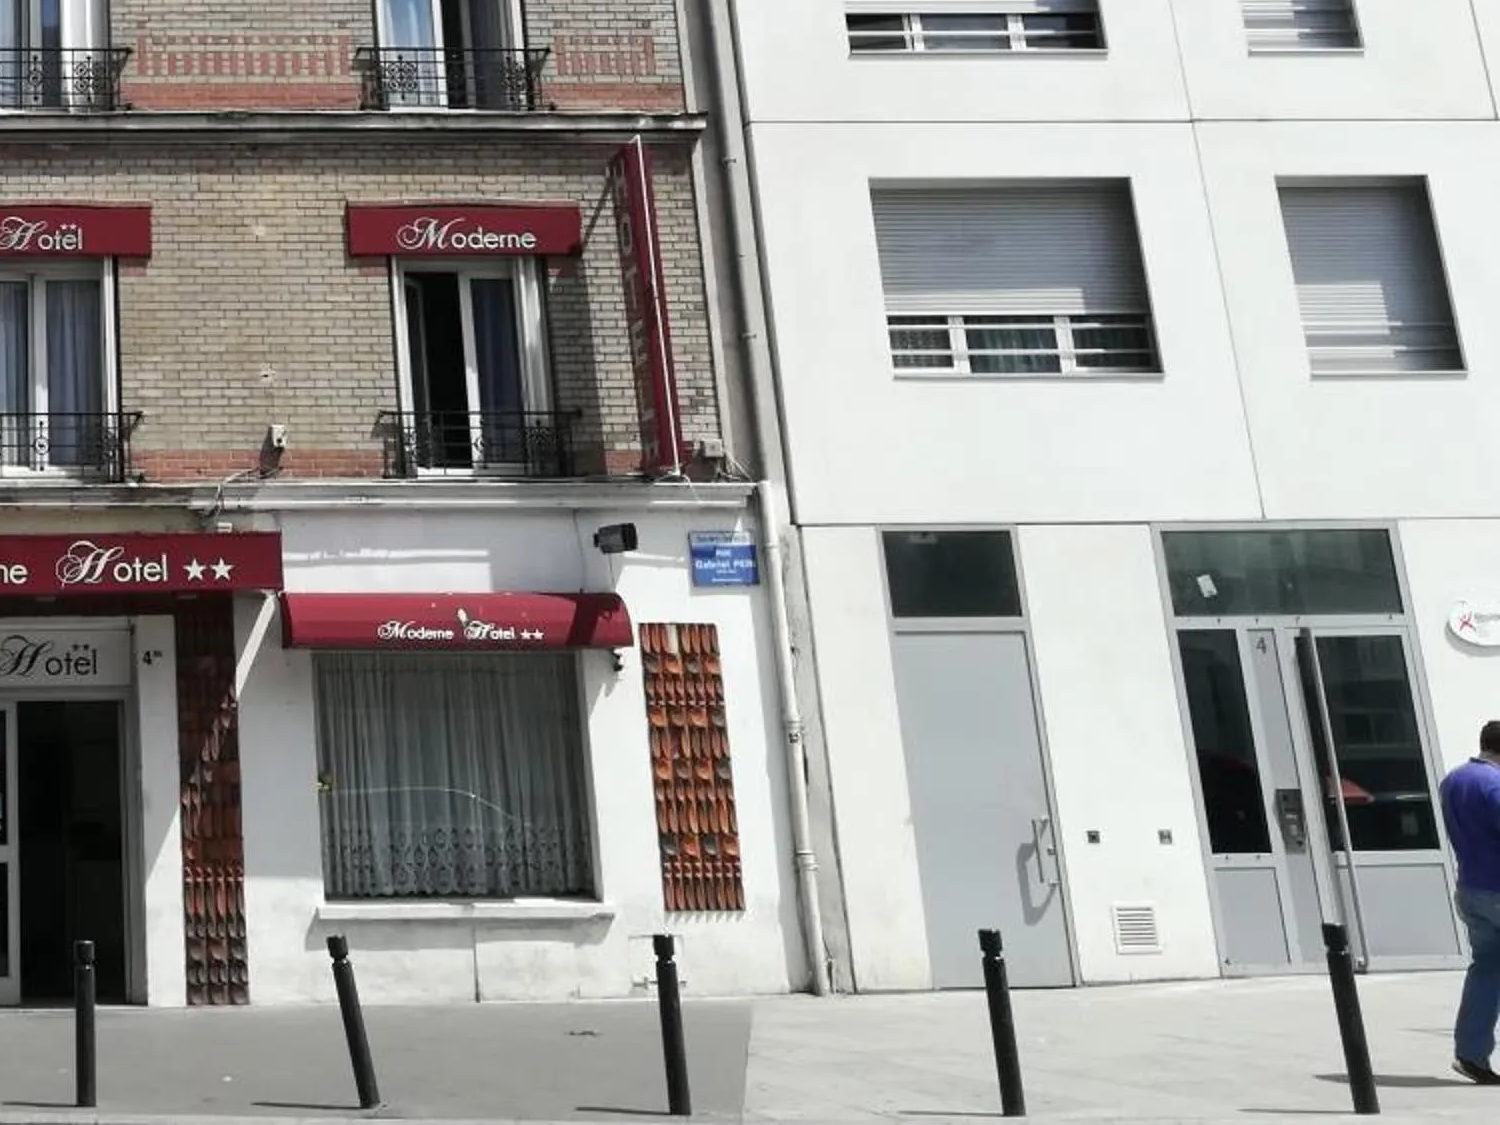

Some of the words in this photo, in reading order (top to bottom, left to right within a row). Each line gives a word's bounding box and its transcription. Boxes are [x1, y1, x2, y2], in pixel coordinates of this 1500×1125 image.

[396, 217, 537, 250] Moderne
[55, 540, 168, 587] Hotel
[377, 620, 454, 640] Moderne
[464, 620, 516, 640] Hotel
[1255, 637, 1267, 654] 4
